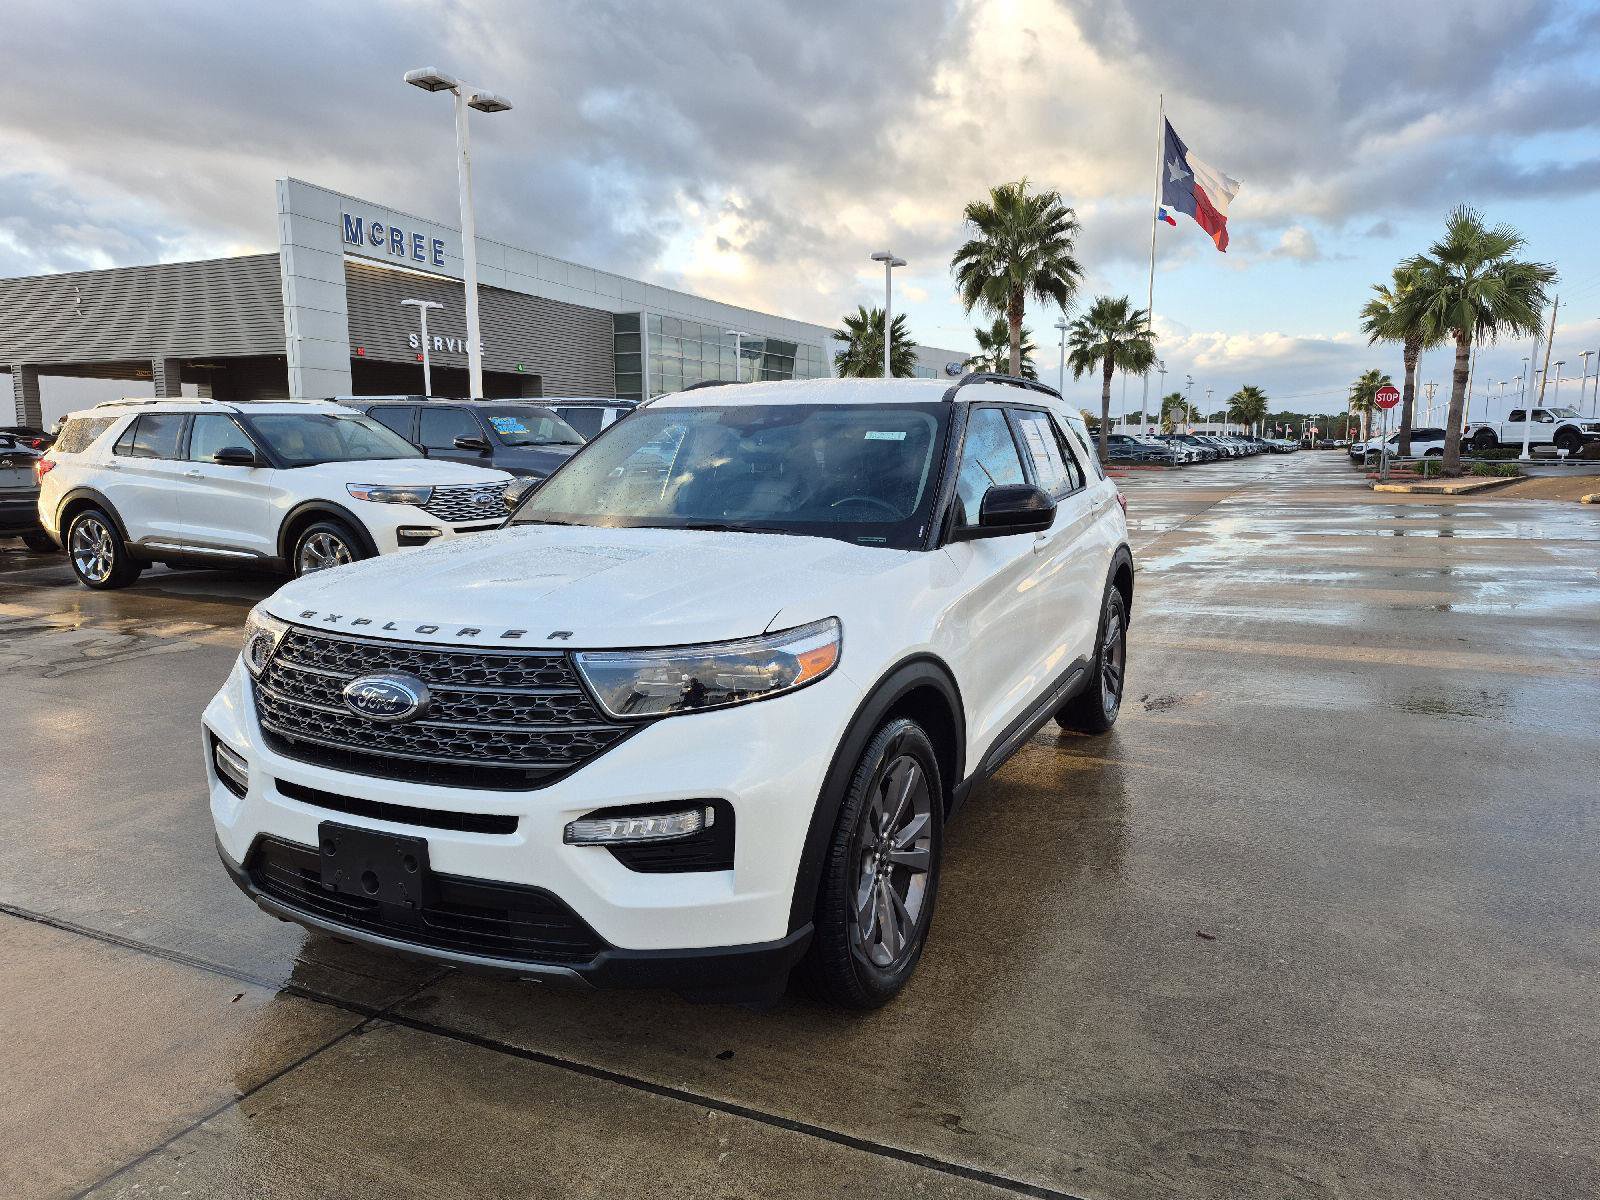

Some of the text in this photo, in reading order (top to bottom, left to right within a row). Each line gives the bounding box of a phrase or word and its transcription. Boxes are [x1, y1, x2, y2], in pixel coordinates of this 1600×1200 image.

[1376, 393, 1399, 402] STOP
[298, 610, 574, 641] EXPLORER
[358, 686, 399, 711] Ford
